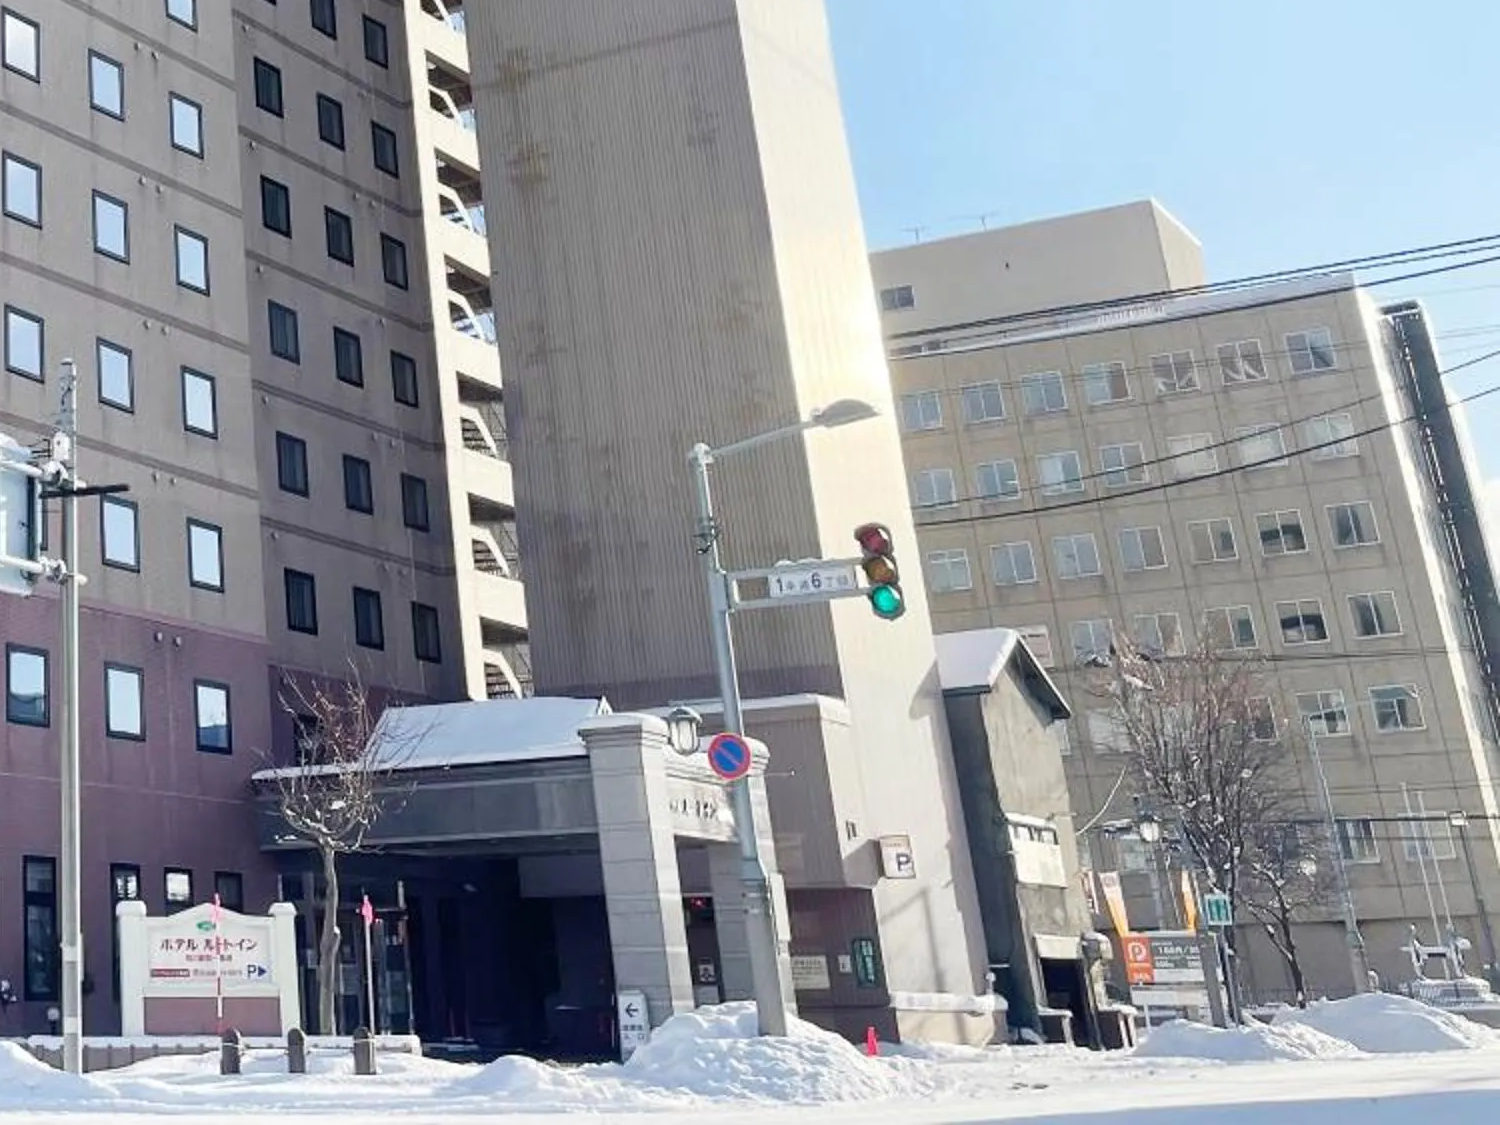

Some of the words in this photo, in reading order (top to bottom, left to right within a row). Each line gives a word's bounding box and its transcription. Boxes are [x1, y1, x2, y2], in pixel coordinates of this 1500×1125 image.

[895, 852, 911, 872] P
[160, 938, 198, 951] ホテル
[247, 964, 257, 978] P
